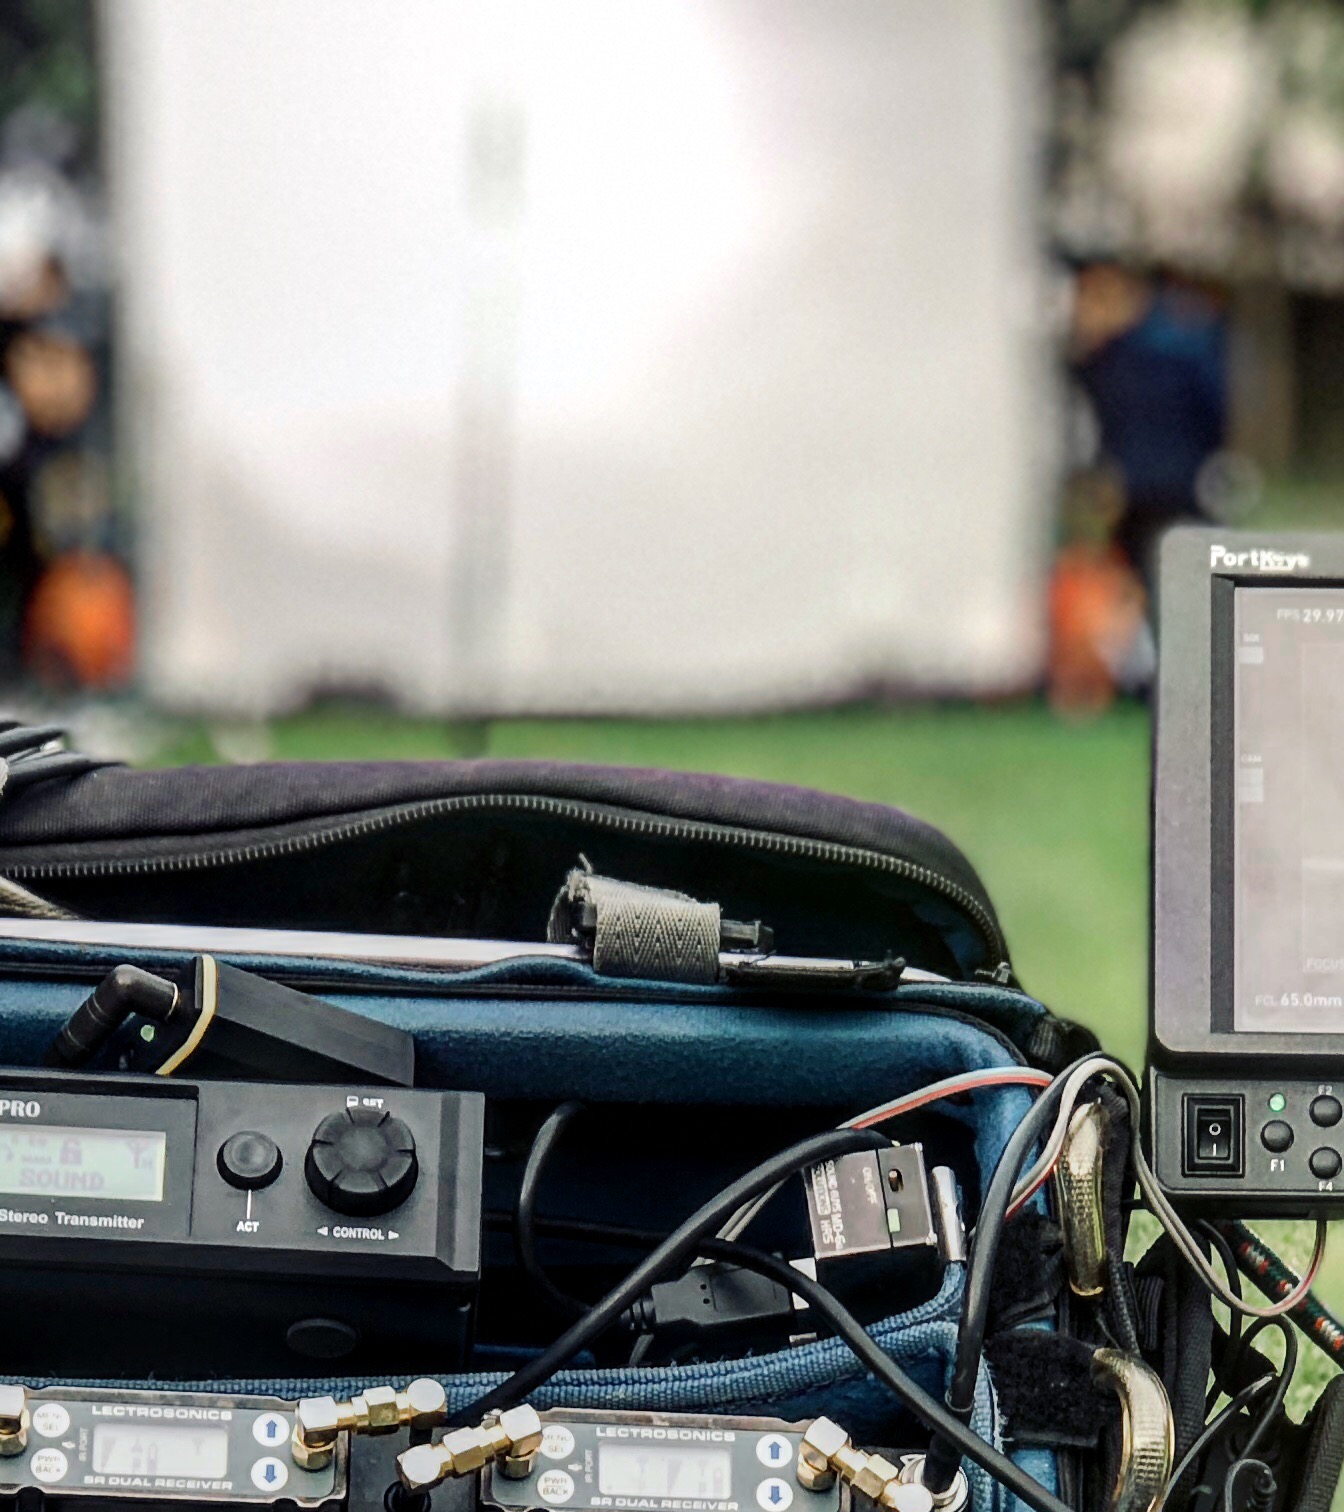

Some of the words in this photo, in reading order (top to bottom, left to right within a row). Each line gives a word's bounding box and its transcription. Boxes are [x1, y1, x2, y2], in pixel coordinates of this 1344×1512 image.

[1280, 993, 1343, 1008] 65.0mm
[1270, 1159, 1286, 1172] F1
[18, 1169, 105, 1191] SOUND
[54, 1211, 144, 1231] Transmitter
[236, 1220, 260, 1233] ACT
[332, 1226, 385, 1241] CONTROL
[91, 1405, 233, 1422] LECTROSONICS
[596, 1426, 736, 1443] LECTROSONICS
[109, 1476, 151, 1488] DUAL
[155, 1477, 233, 1491] RECEIVER
